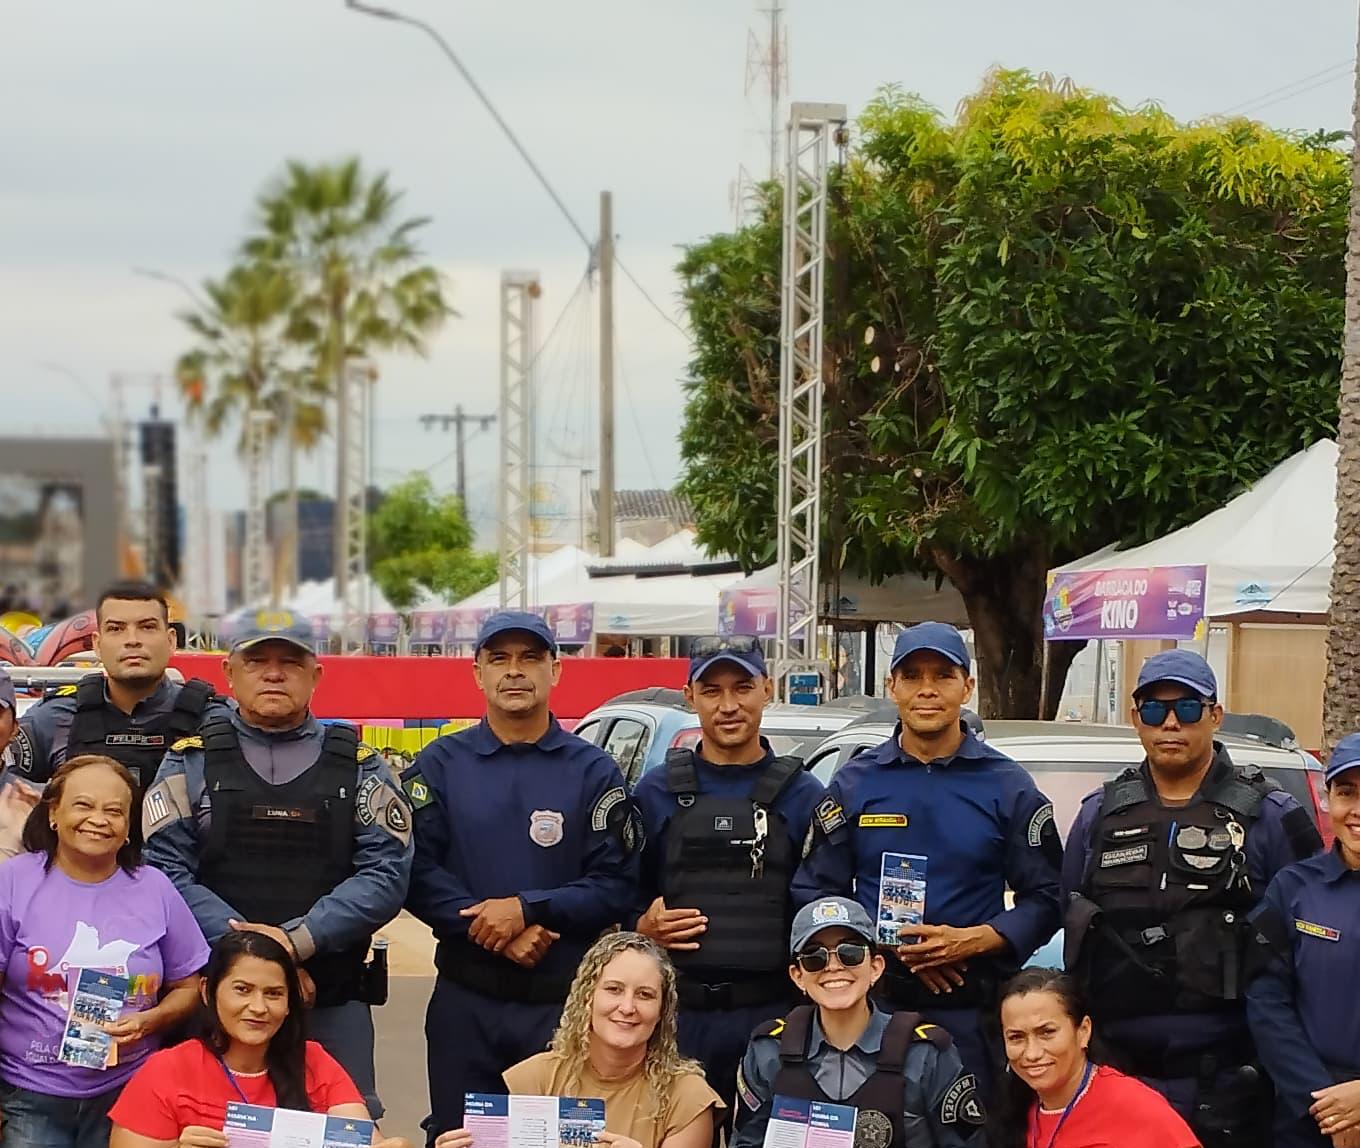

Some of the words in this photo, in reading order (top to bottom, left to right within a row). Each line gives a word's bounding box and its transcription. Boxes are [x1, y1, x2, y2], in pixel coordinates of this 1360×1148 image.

[1094, 582, 1134, 596] BARRACA
[1135, 580, 1148, 595] DO
[1100, 600, 1139, 629] KINO
